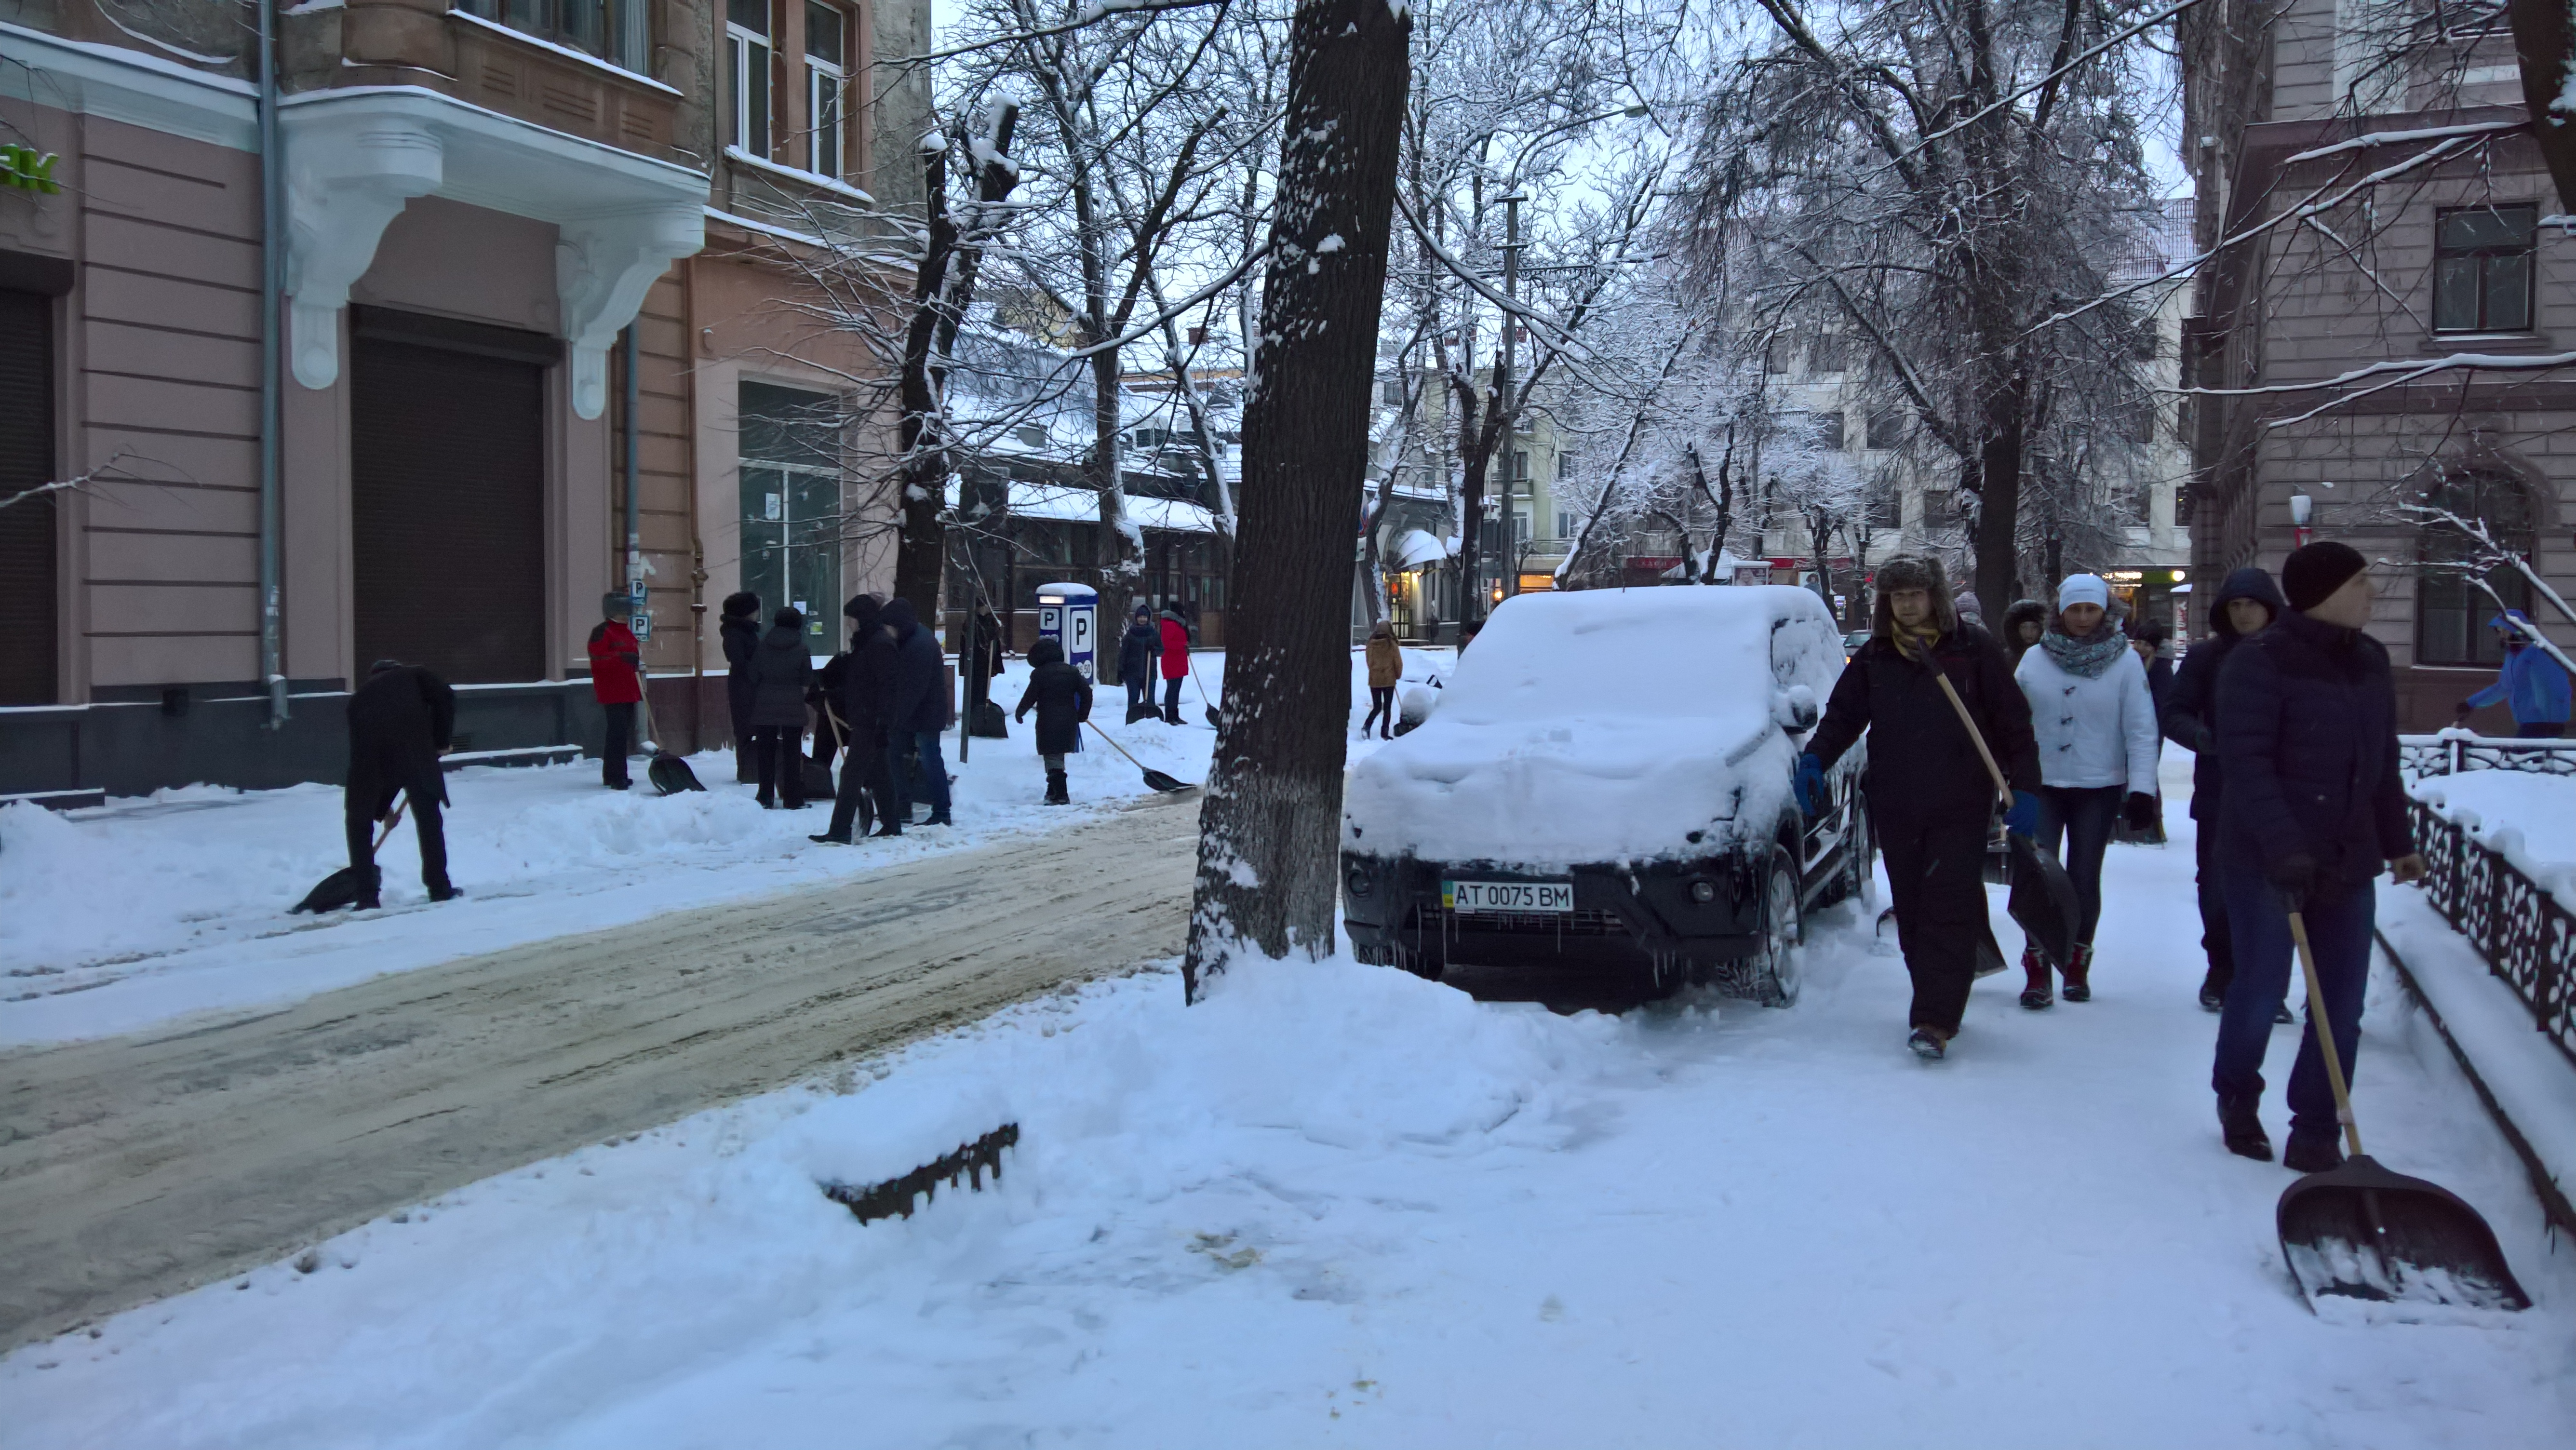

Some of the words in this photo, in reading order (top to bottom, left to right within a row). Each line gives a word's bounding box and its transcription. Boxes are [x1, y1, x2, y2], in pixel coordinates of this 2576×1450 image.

[636, 582, 643, 593] P
[636, 618, 644, 631] P
[1045, 612, 1054, 626] P
[1076, 618, 1087, 645] P
[1456, 885, 1482, 904] AT
[1489, 886, 1533, 905] 0075
[1540, 888, 1569, 907] BM
